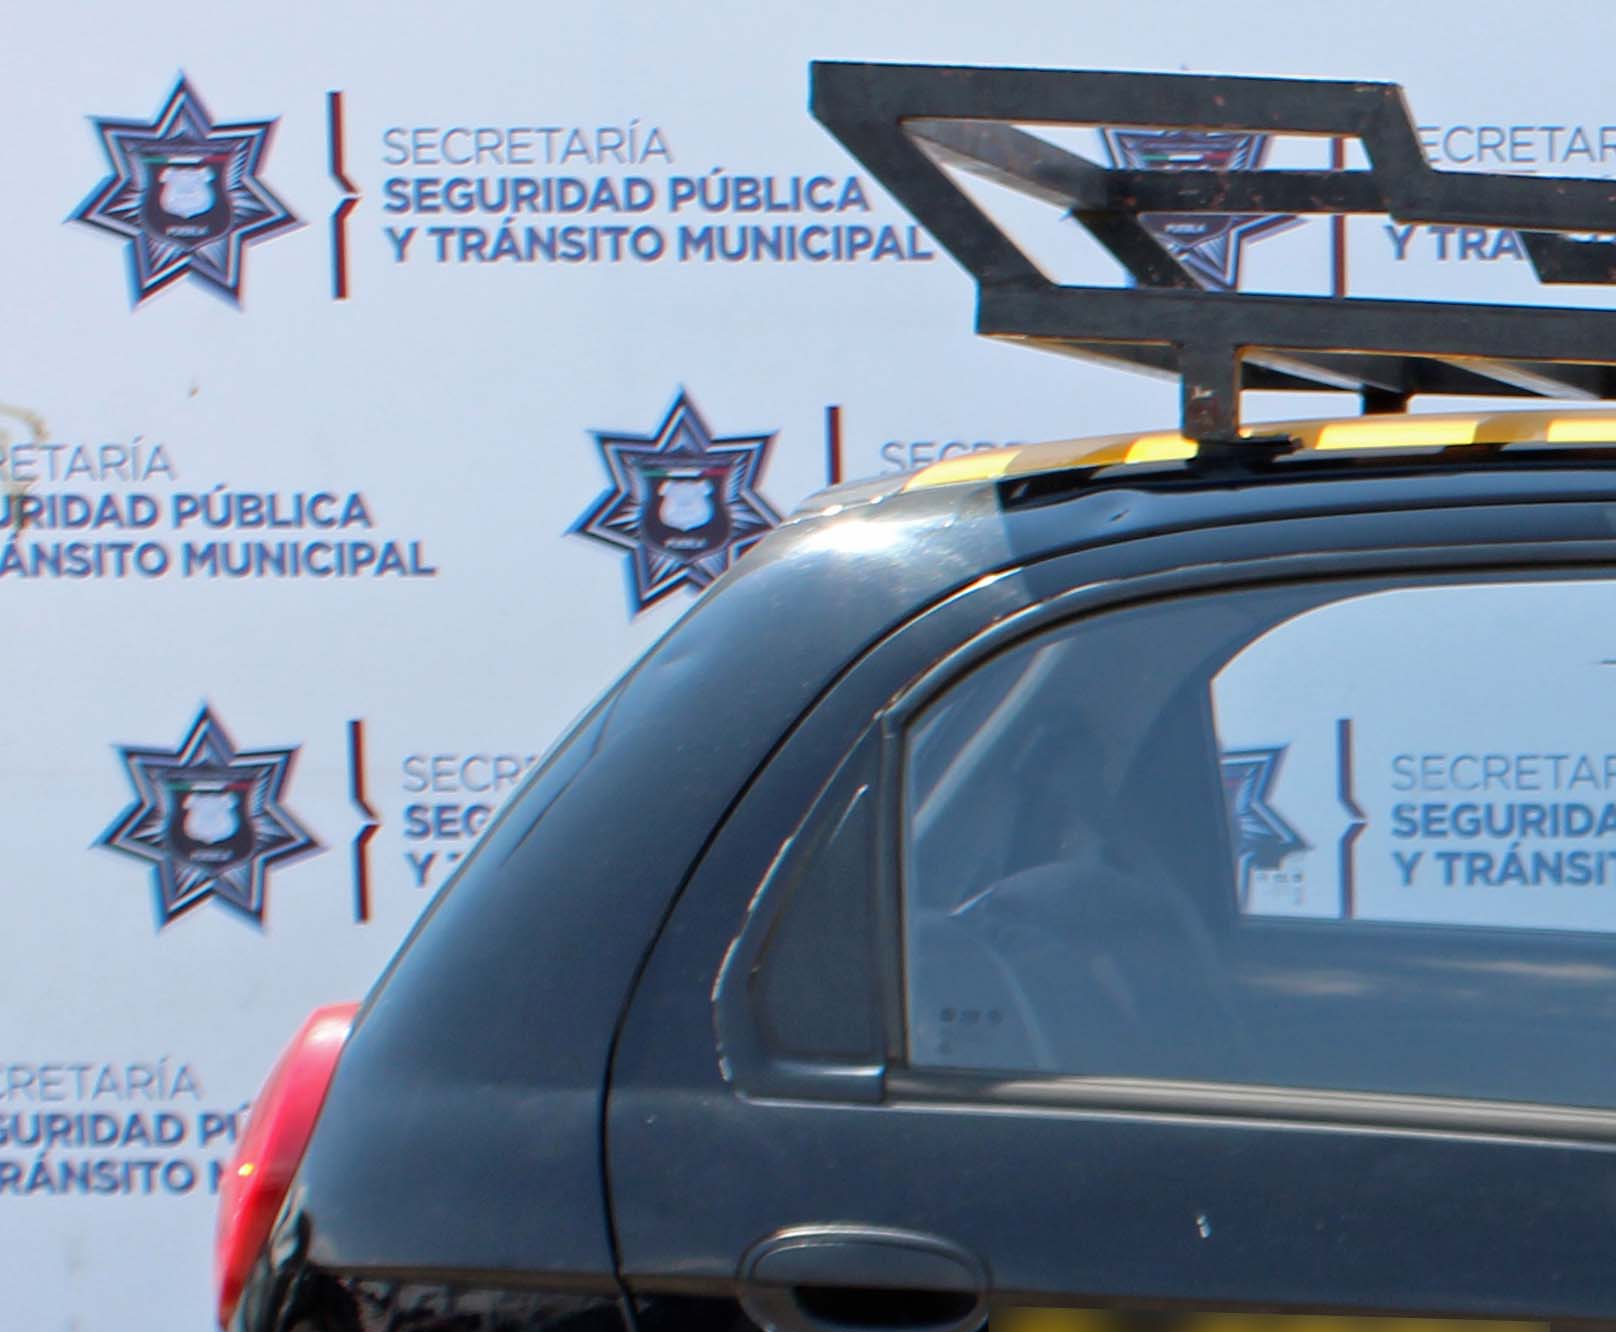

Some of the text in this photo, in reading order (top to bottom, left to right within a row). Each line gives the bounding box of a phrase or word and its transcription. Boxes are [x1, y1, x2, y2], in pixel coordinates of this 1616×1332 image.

[382, 118, 673, 166] SECRETARÍA
[383, 165, 872, 214] SEGURIDAD PÚBLICA
[384, 216, 937, 263] Y TRÁNSITO MUNICIPAL
[0, 436, 177, 482] ETARÍA
[172, 484, 373, 529] PÚBLICA
[0, 532, 437, 578] ÁNSITO MUNICIPAL
[1391, 850, 1423, 887] Y
[0, 1058, 200, 1100] RETARÍA
[0, 1112, 188, 1150] URIDAD
[0, 1152, 197, 1196] RÁNSITO
